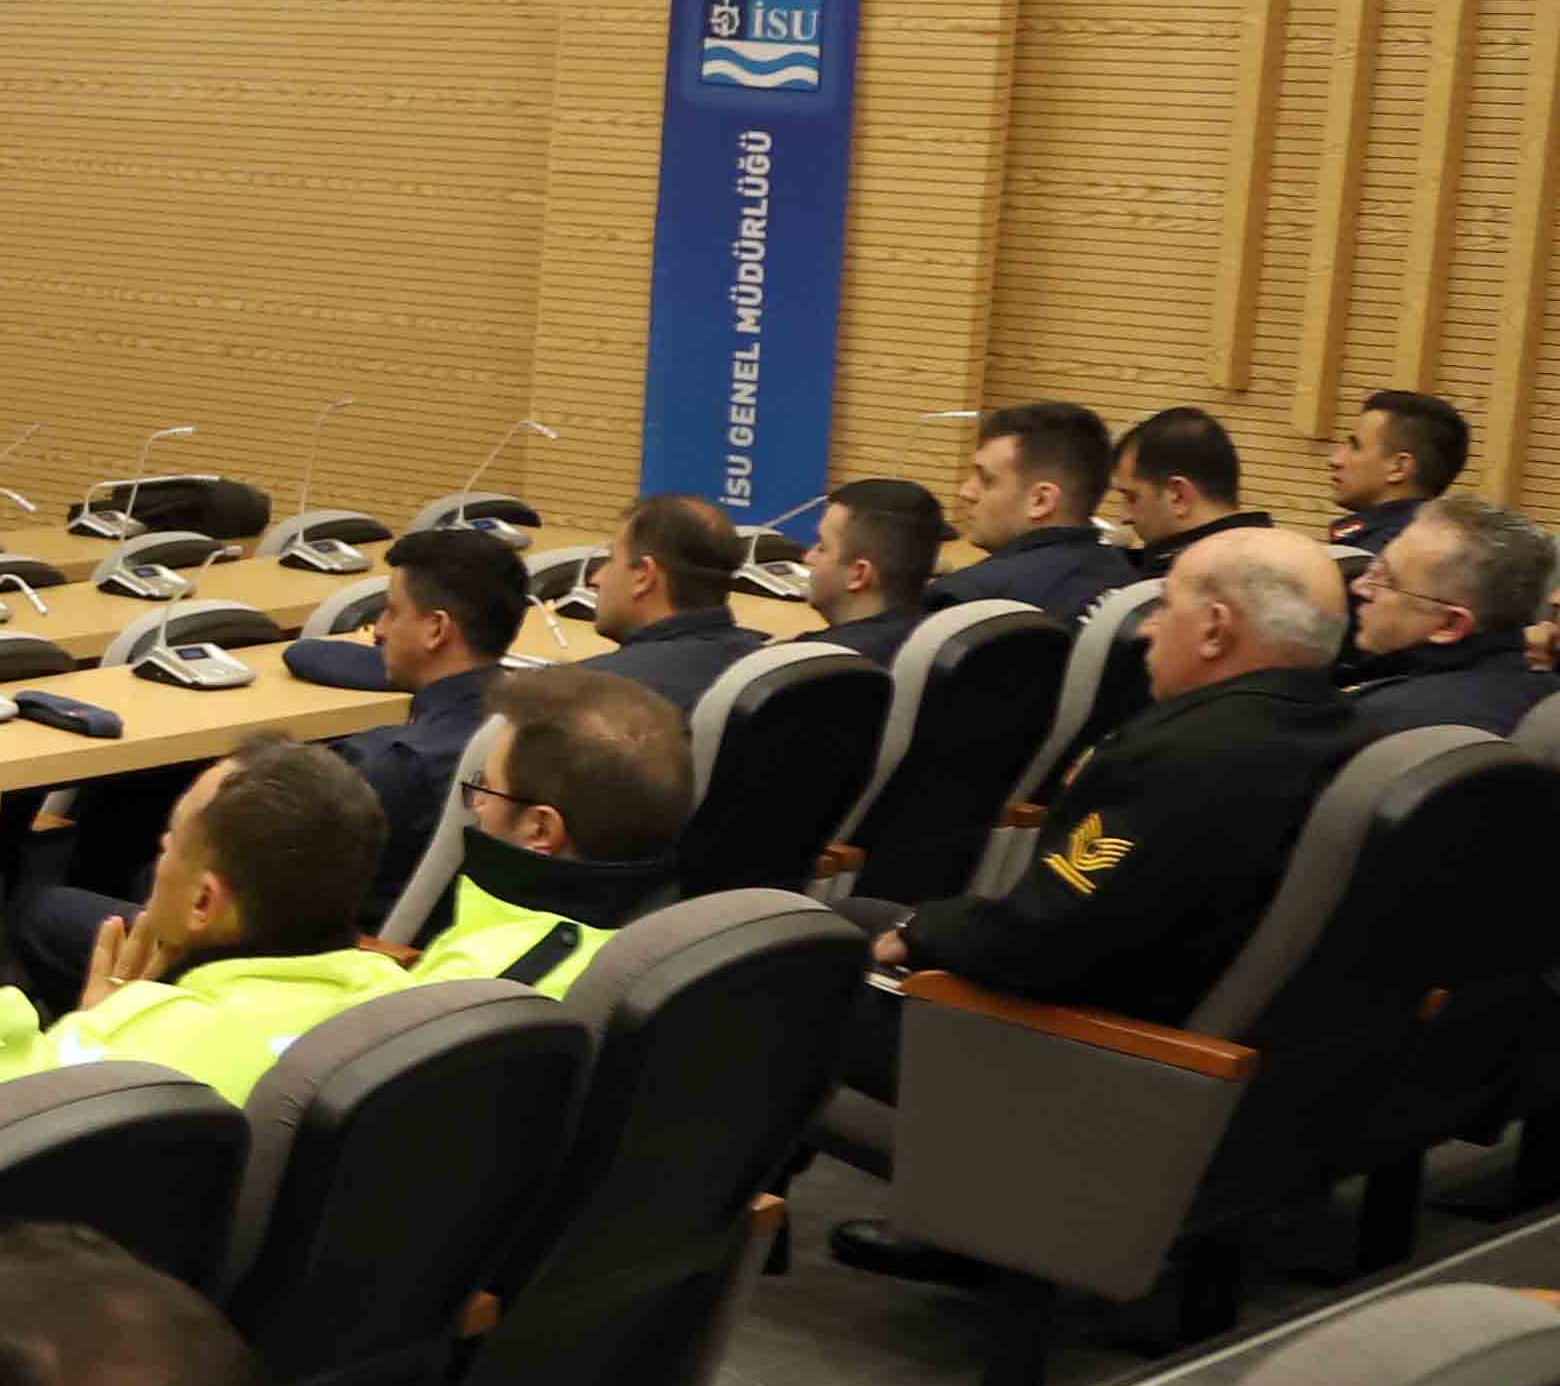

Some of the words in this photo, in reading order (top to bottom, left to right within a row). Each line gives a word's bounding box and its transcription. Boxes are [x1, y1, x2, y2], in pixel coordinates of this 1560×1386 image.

[730, 130, 773, 334] MÜDÜRLÜĞÜ
[728, 342, 760, 447] GENEL
[719, 454, 753, 508] İSU
